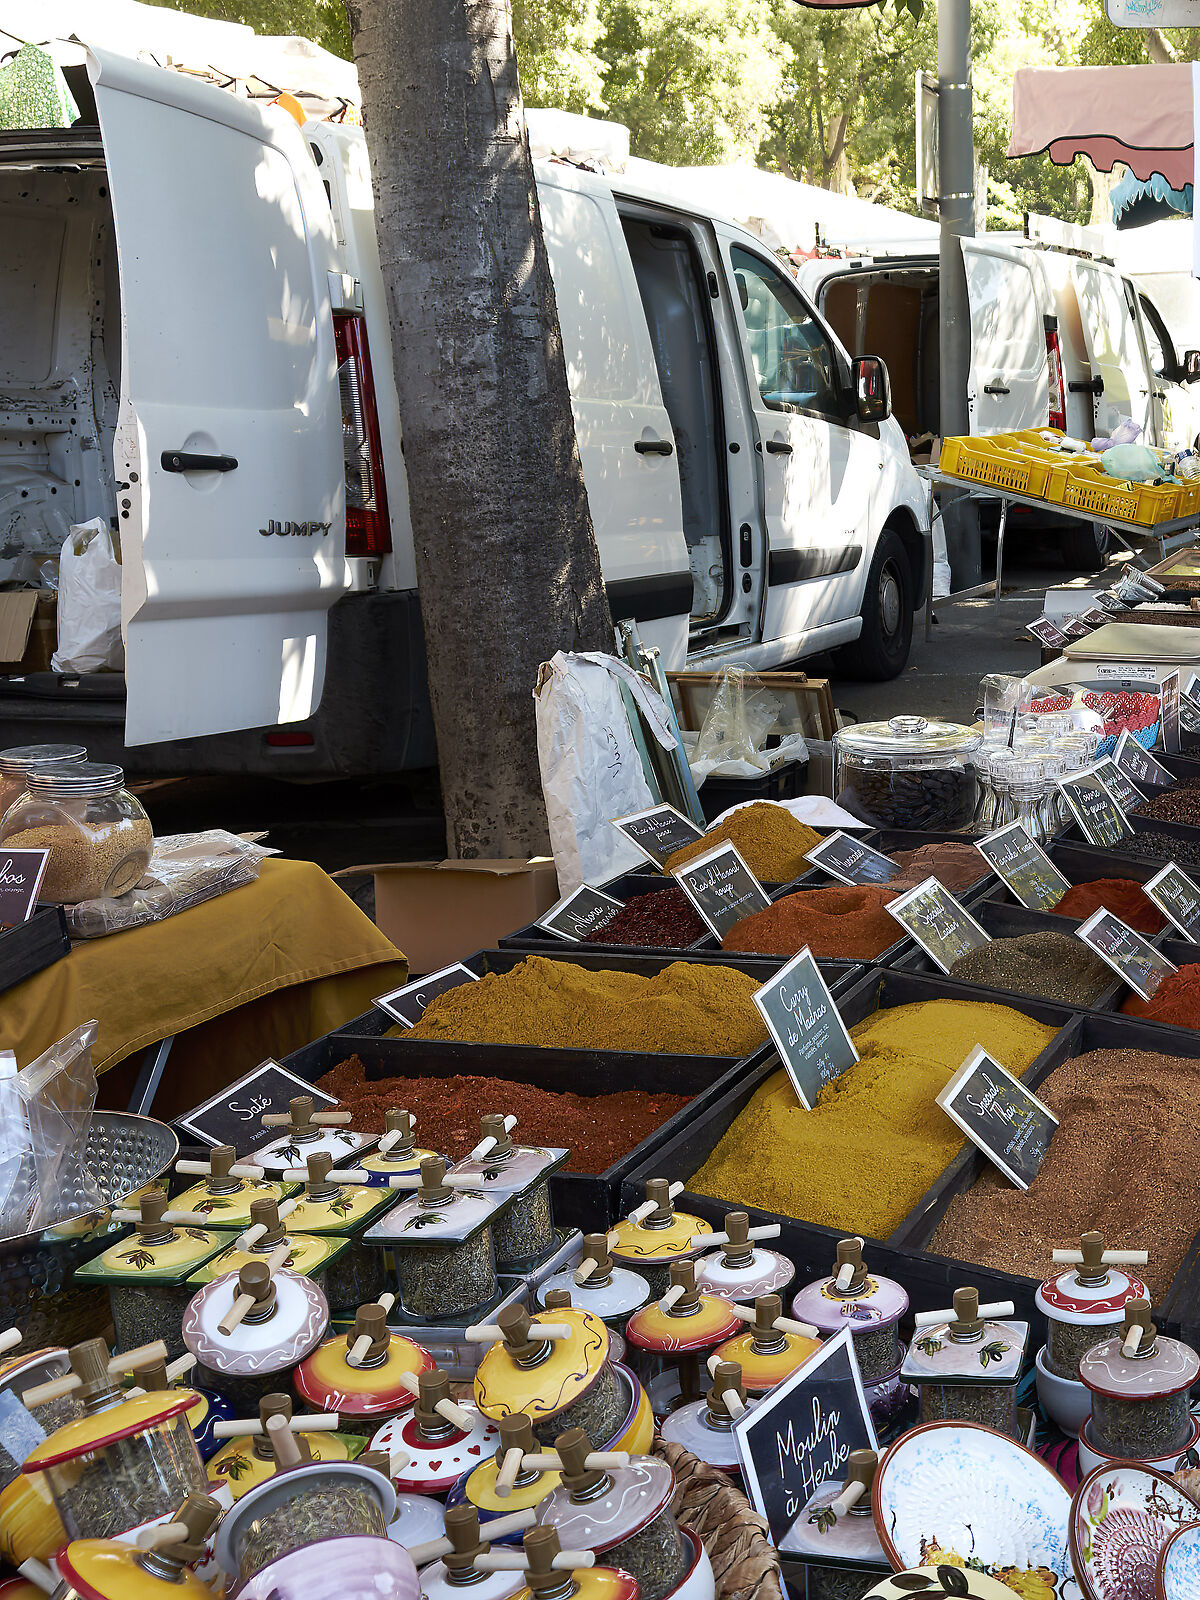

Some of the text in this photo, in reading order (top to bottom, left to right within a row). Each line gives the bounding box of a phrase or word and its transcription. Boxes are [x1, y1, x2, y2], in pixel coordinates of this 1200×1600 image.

[259, 520, 332, 536] JUMPY
[827, 847, 865, 872] Muscade
[689, 860, 740, 894] Ras el Hanout
[714, 883, 734, 898] rouge
[779, 985, 812, 1013] Curry
[787, 1003, 827, 1047] de Madras
[228, 1093, 272, 1121] Saté
[776, 1396, 841, 1479] Moulin
[784, 1430, 849, 1518] à Herbe
